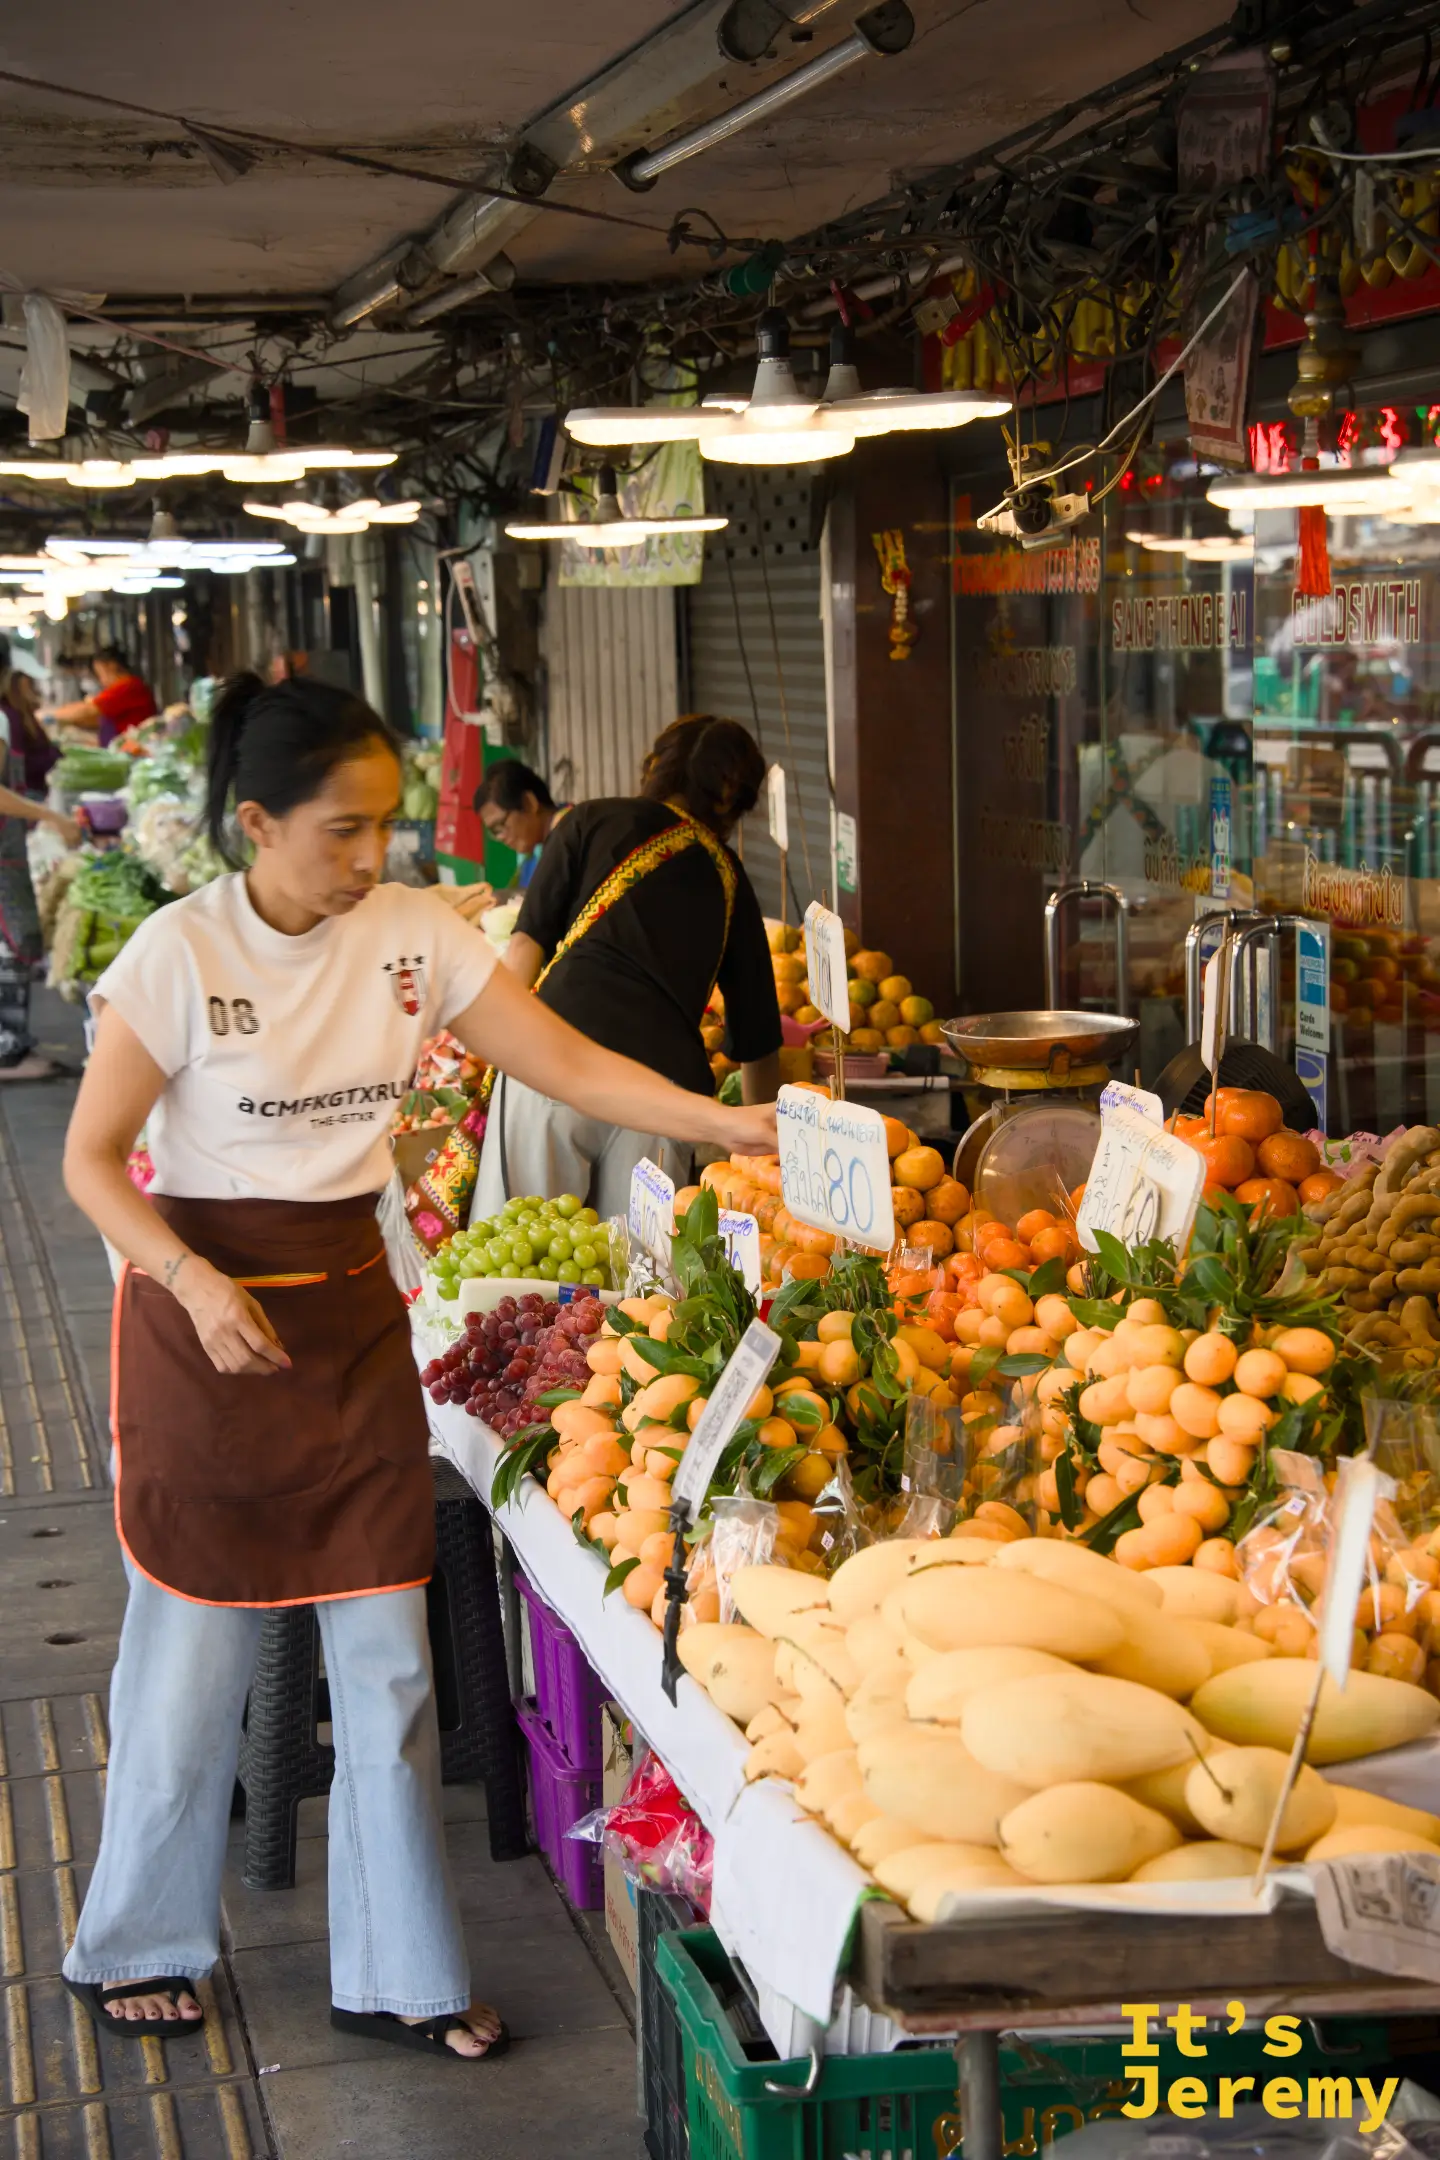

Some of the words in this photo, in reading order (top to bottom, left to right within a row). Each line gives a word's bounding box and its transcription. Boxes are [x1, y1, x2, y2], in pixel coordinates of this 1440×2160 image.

[1112, 598, 1154, 651] SANG
[1156, 593, 1212, 650] THONG
[1214, 591, 1246, 648] BAI
[1292, 579, 1421, 645] GOLDSMITH
[208, 996, 260, 1035] 08
[1300, 1011, 1315, 1024] Cards
[1300, 1024, 1325, 1040] Welcome
[823, 1147, 874, 1235] 80
